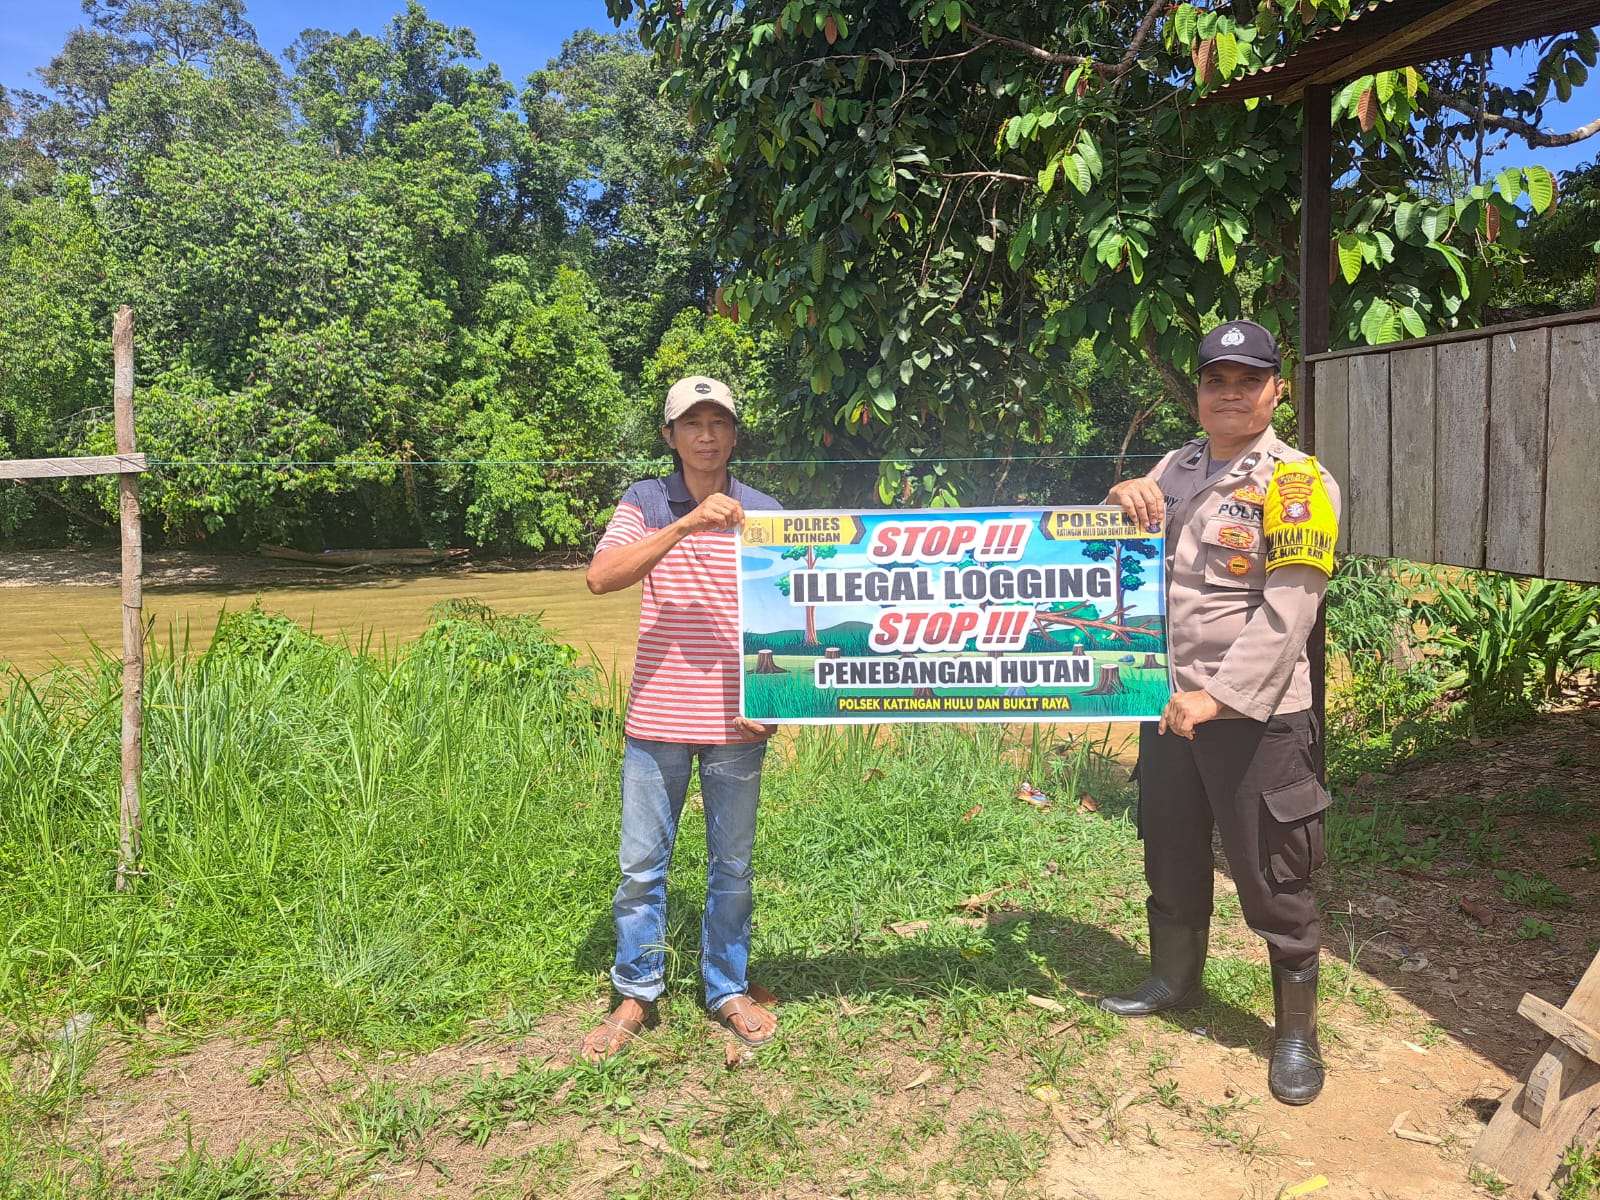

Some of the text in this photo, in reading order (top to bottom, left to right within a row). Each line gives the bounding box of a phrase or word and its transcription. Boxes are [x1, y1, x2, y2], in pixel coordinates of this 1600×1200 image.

[1164, 495, 1179, 507] NY
[1218, 502, 1263, 521] POLR
[783, 517, 840, 532] POLRES
[1056, 527, 1137, 537] KATINGAN HULU DAN BUKIT RAYA
[783, 532, 841, 544] KATINGAN
[872, 523, 1027, 558] STOP !!!
[793, 567, 1112, 603] ILLEGAL LOGGING
[873, 610, 1029, 646] STOP !!!
[818, 658, 1091, 685] PENEBANGAN HUTAN
[838, 696, 1070, 711] POLSEK KATINGAN HULU DAN BUKIT RAYA
